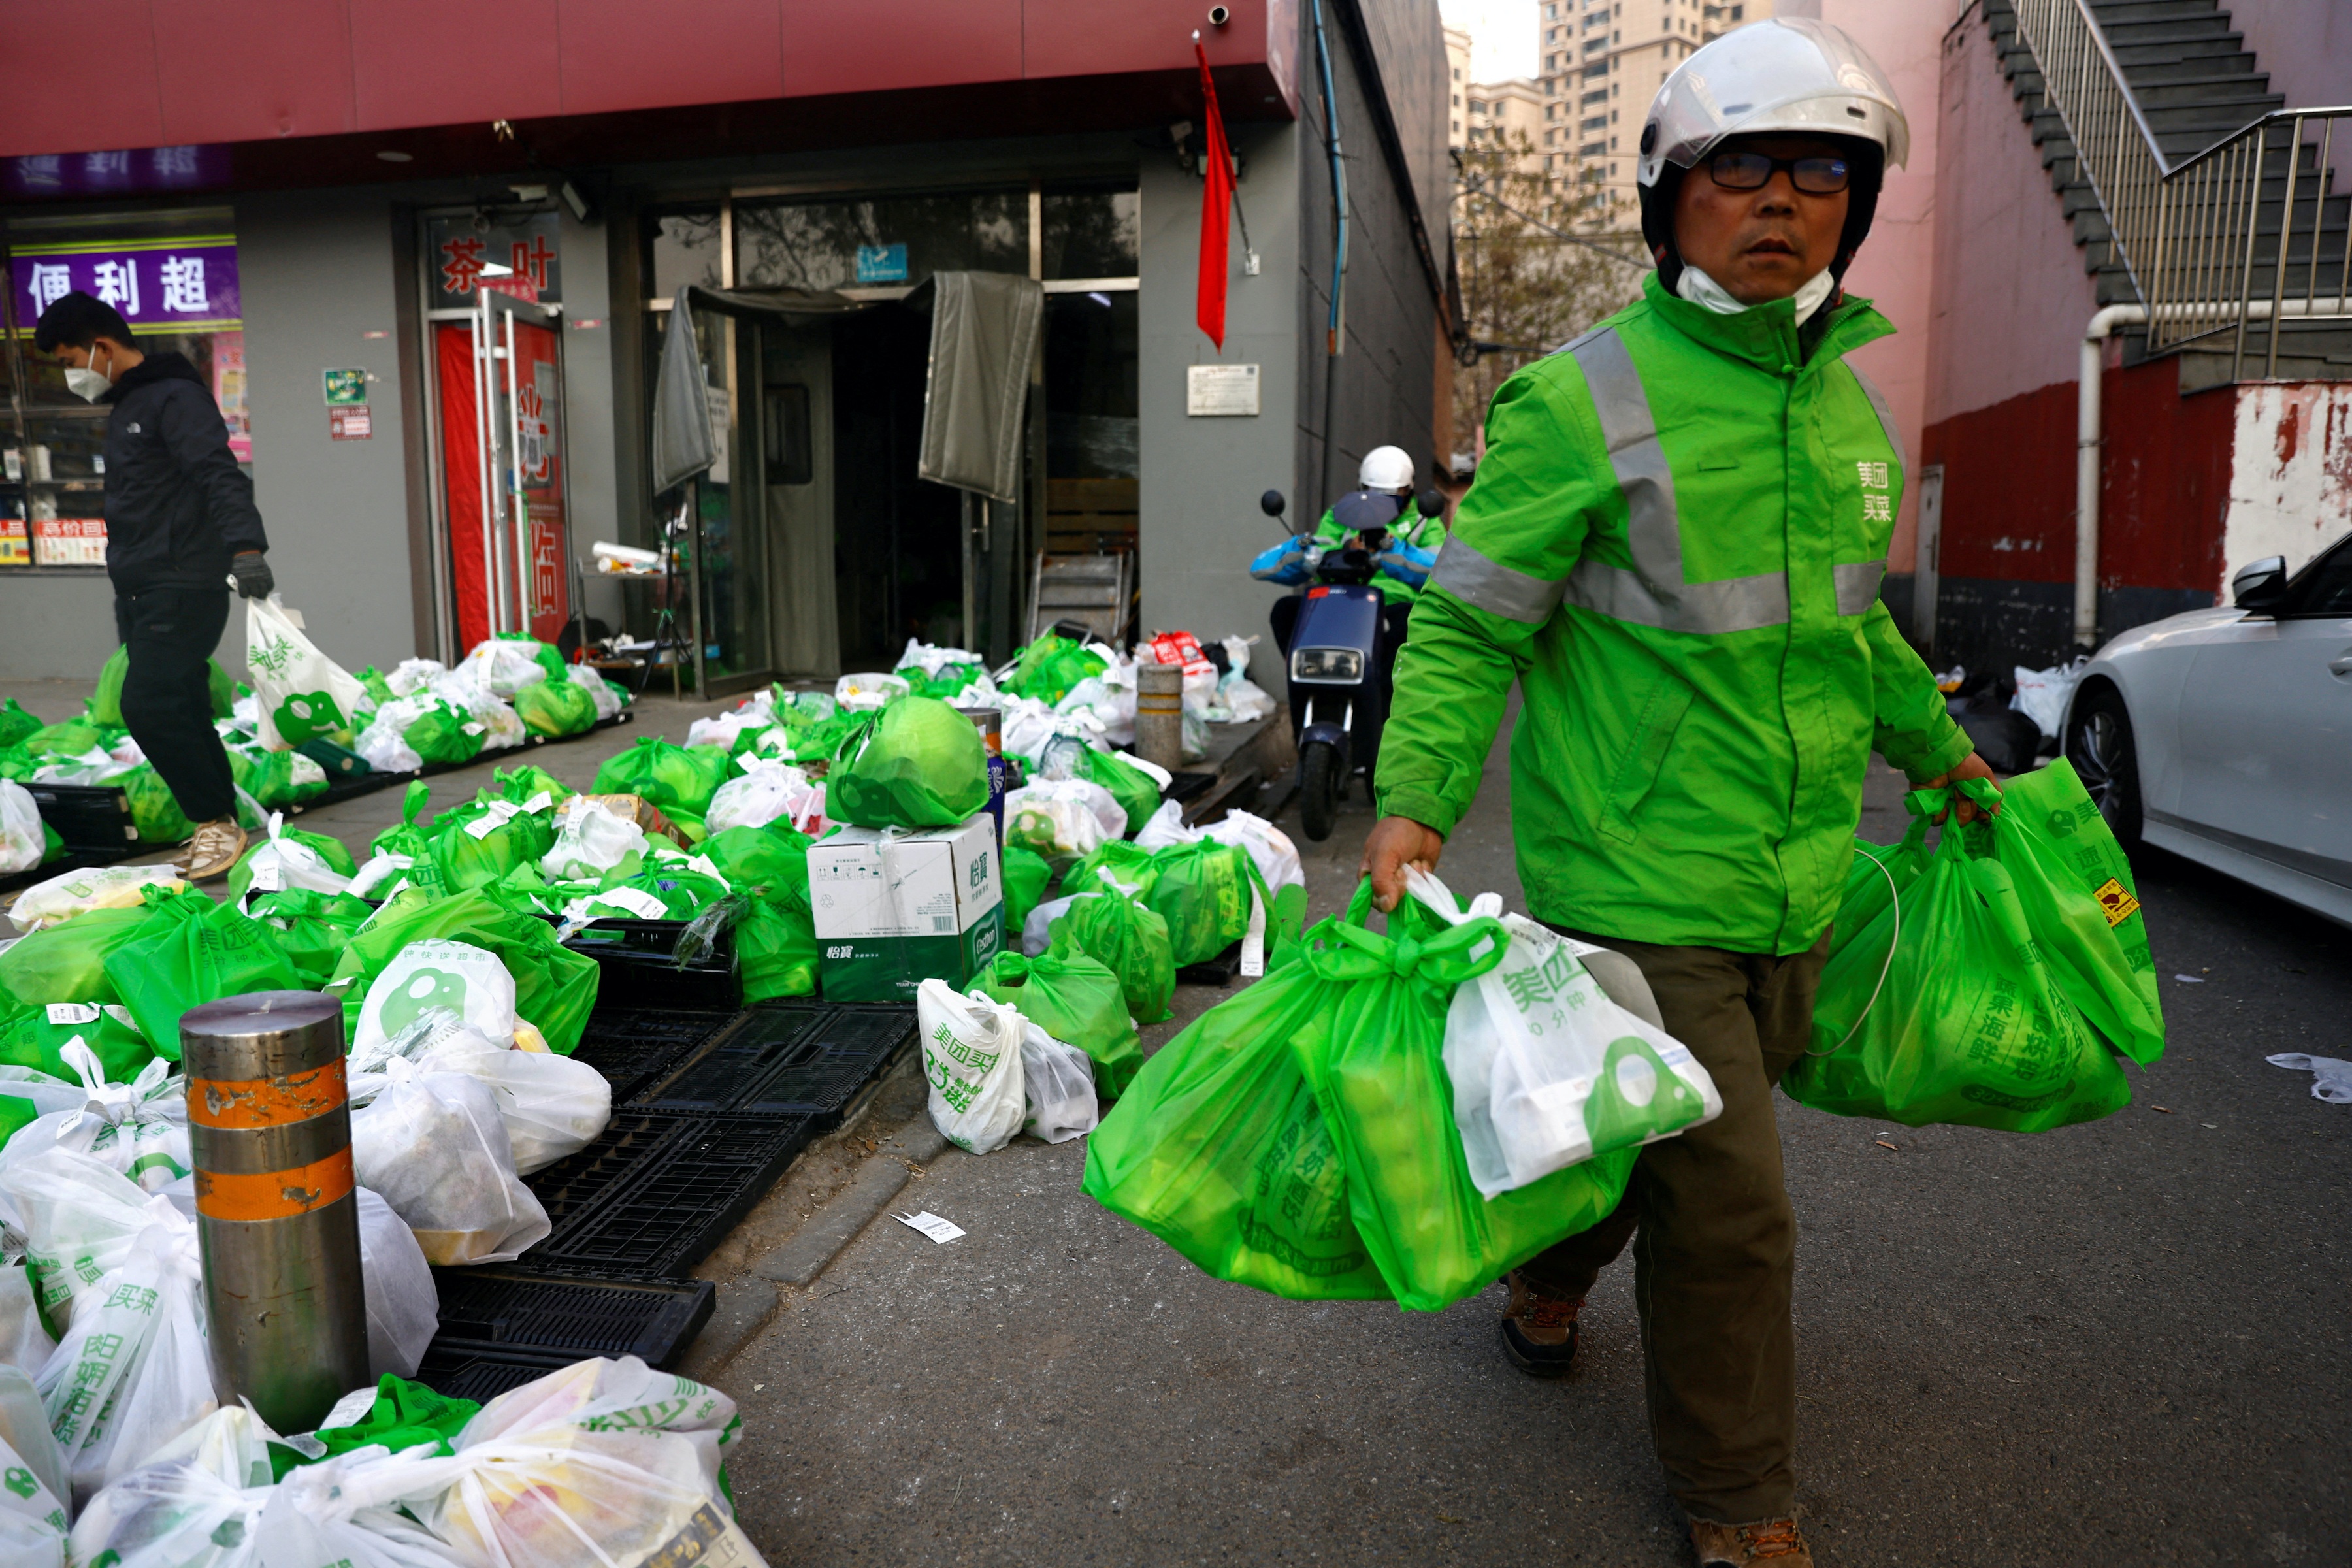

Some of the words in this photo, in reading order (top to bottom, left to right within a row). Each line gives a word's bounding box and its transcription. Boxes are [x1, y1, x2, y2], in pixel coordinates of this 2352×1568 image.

[442, 235, 557, 294] 茶叶
[28, 255, 210, 318] 便利超
[1856, 461, 1889, 489] 美团
[1863, 494, 1892, 521] 买菜
[403, 949, 487, 962] 钟快送超市
[1967, 973, 2017, 1065] 蔬果海鲜
[103, 1283, 159, 1316] 买菜
